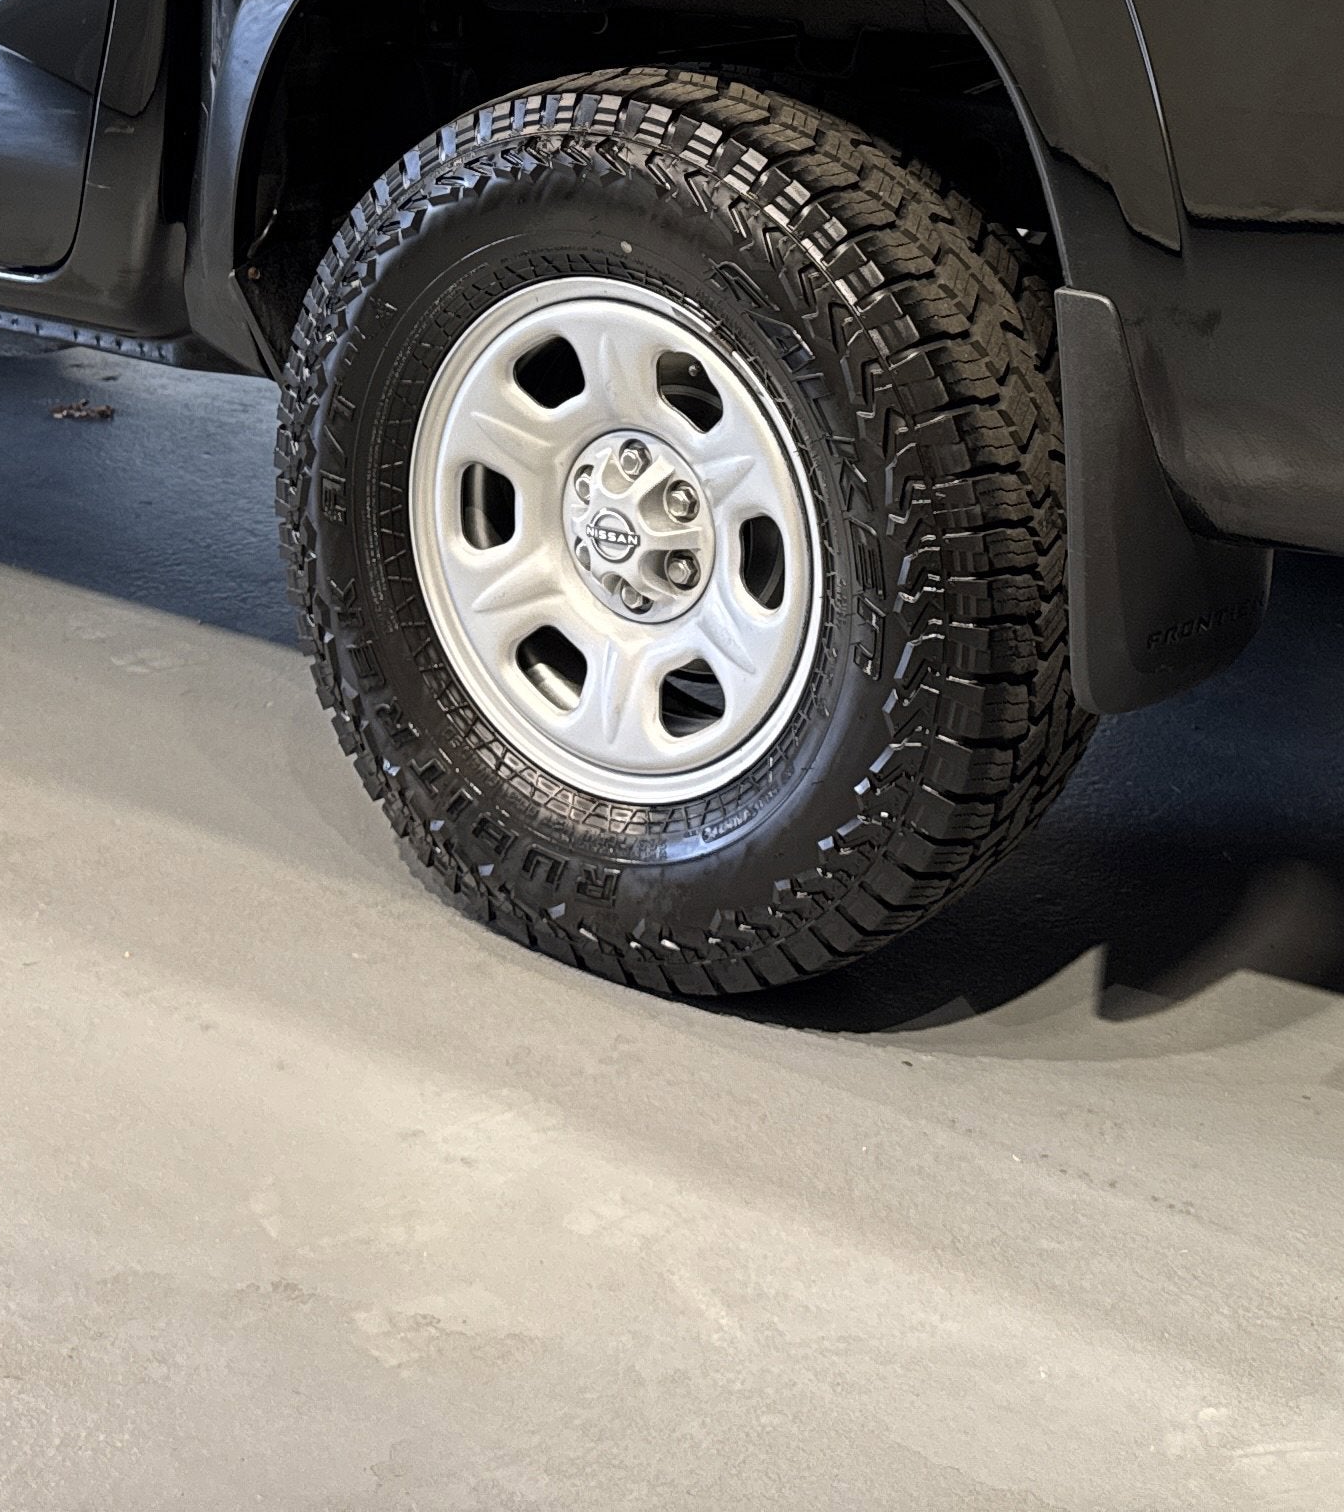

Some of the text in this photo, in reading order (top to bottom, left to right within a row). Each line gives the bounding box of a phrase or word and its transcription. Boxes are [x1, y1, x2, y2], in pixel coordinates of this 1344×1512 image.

[586, 526, 639, 545] NISSAN
[703, 255, 886, 682] FALKEN
[327, 574, 623, 908] RUBITREK
